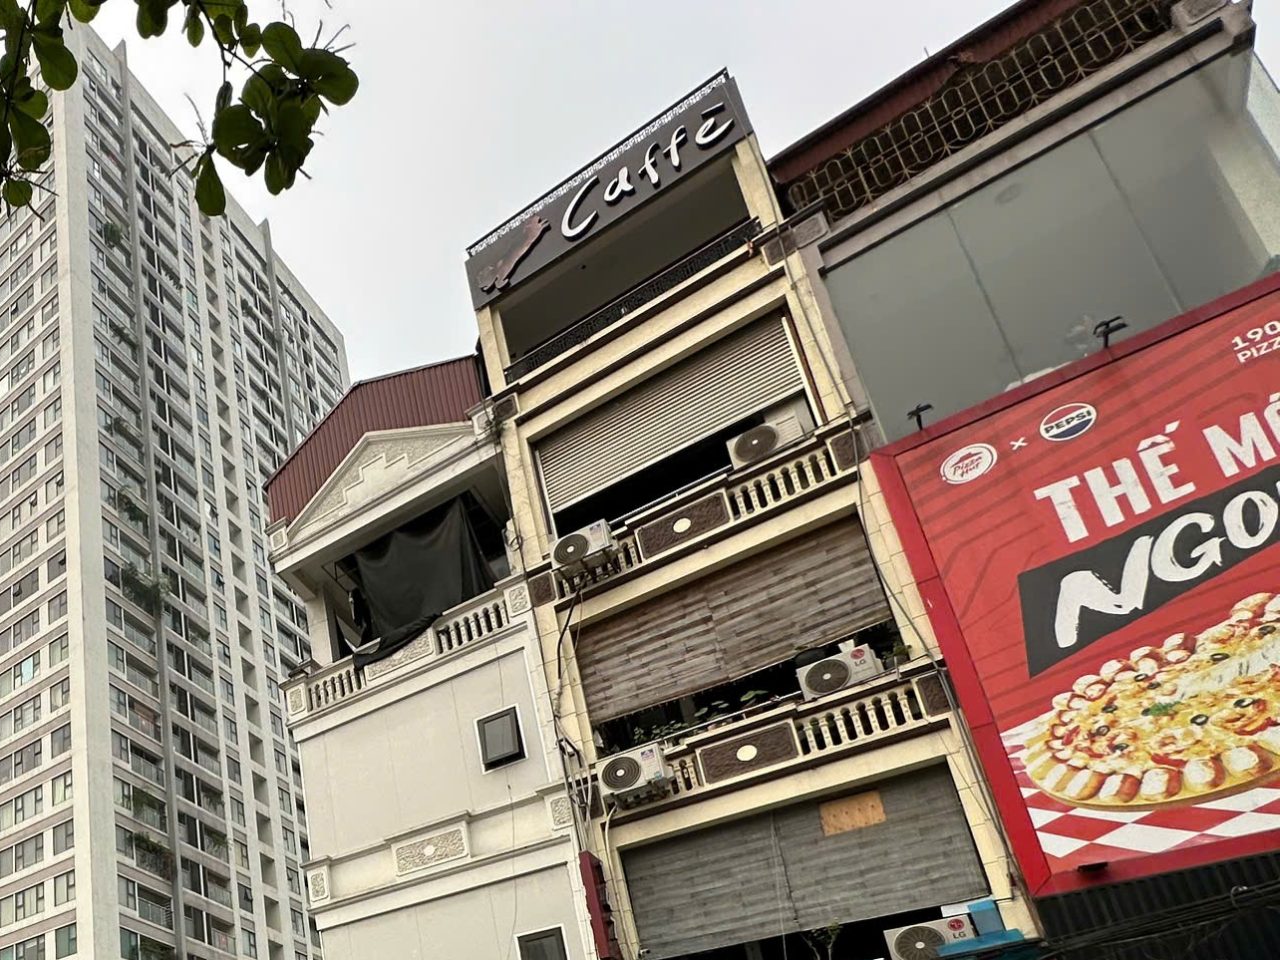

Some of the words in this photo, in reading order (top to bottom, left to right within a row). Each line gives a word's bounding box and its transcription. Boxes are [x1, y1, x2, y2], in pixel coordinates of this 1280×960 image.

[1044, 409, 1093, 434] PEPSI
[952, 456, 983, 476] Pizza
[960, 463, 981, 479] Hut
[1033, 420, 1196, 543] THẾ
[1054, 480, 1280, 648] NGO
[854, 659, 866, 668] LG
[952, 931, 966, 939] LG
